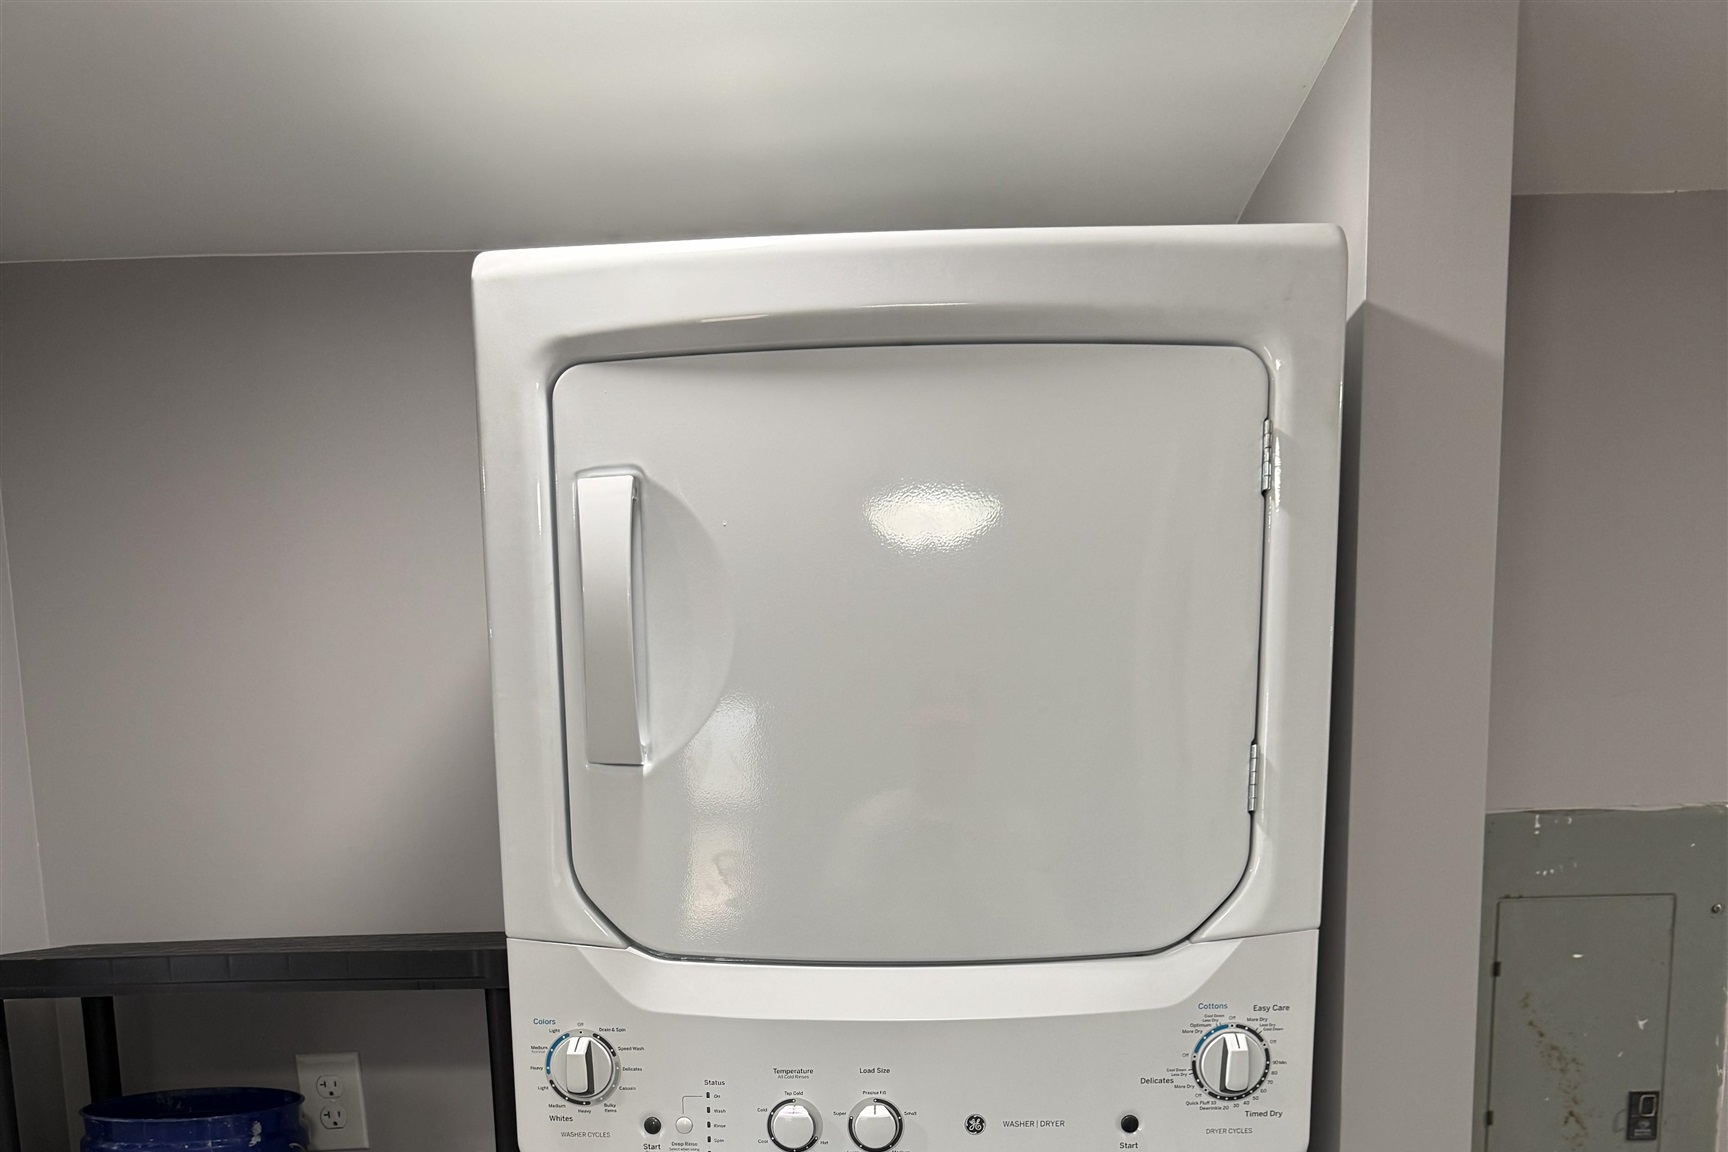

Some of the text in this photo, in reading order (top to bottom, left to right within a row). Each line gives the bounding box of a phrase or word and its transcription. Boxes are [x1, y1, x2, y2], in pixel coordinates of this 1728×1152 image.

[1253, 1004, 1270, 1012] Easy
[1269, 1110, 1283, 1118] Dry
[1002, 1120, 1065, 1128] WASHER DRYER
